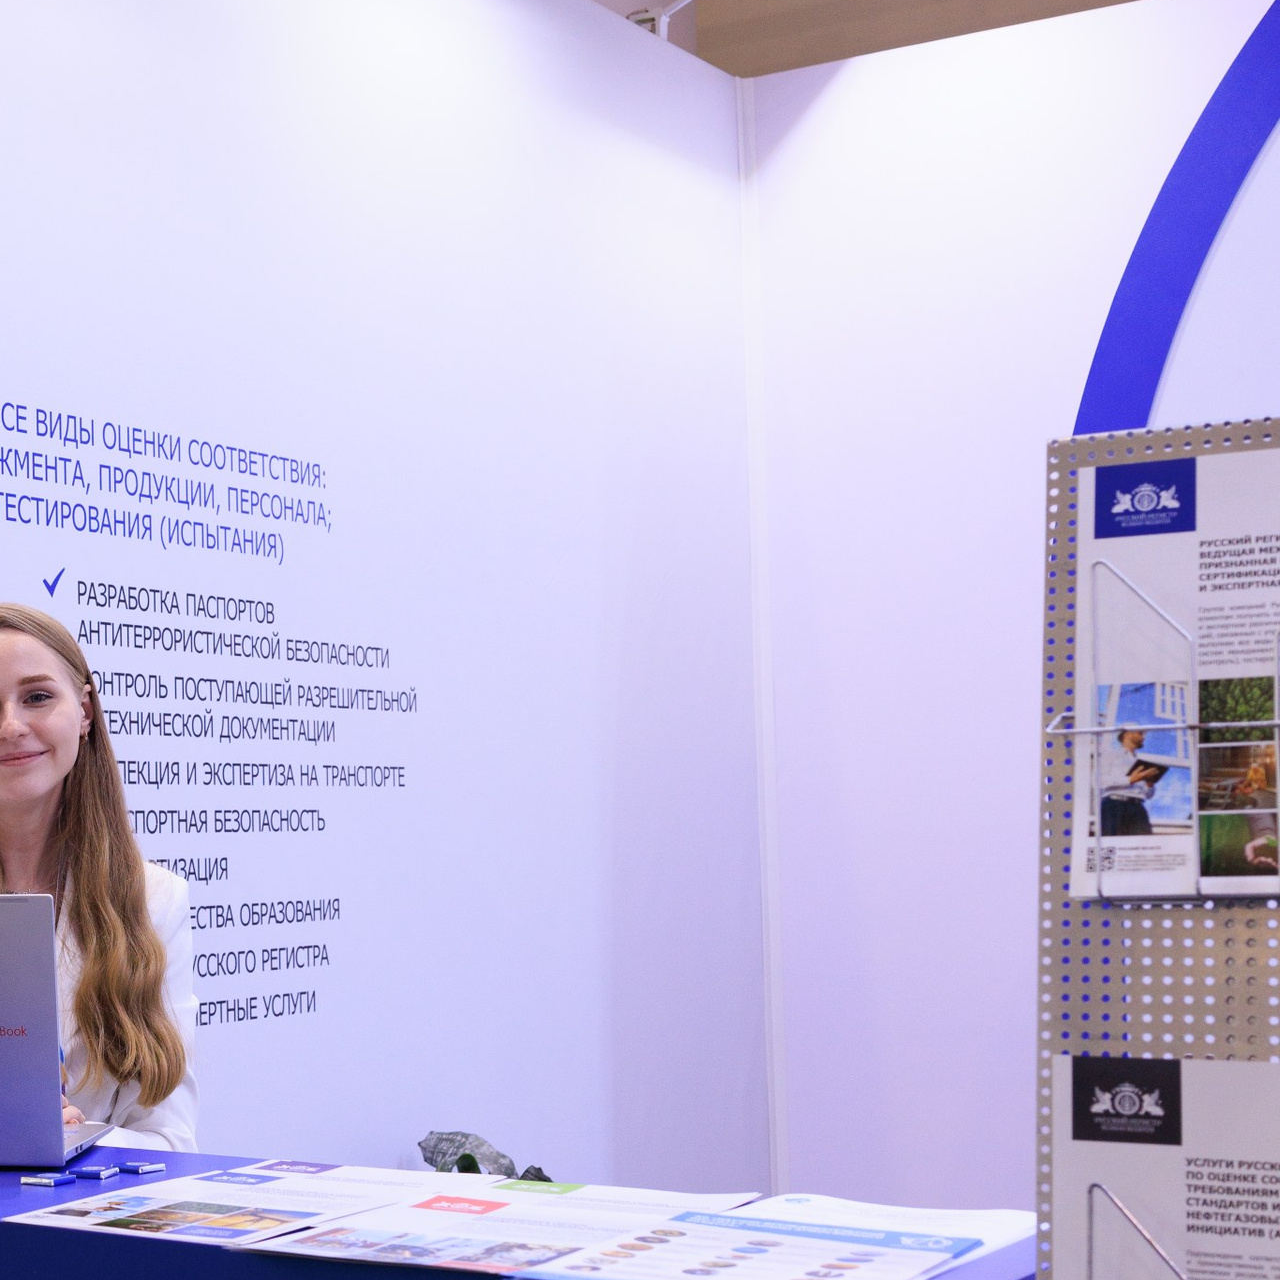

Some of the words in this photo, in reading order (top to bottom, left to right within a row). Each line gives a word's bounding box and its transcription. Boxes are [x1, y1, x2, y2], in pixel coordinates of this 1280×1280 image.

[36, 408, 95, 449] ВИДЫ
[102, 422, 182, 462] ОЦЕНКИ
[188, 439, 326, 489] СООТВЕТСТВИЯ:
[99, 464, 220, 515] ПРОДУКЦИИ,
[228, 486, 331, 533] ПЕРСОНАЛА;
[160, 516, 284, 565] (ИСПЫТАНИЯ)
[1200, 535, 1252, 548] РУССКИЙ
[77, 580, 181, 615] РАЗРАБОТКА
[186, 593, 275, 624] ПАСПОРТОВ
[77, 619, 280, 661] АНТИТЕРРОРИСТИЧЕСКОЙ
[286, 639, 390, 669] БЕЗОПАСНОСТИ
[91, 670, 168, 699] ОНТРОЛЬ
[174, 676, 292, 710] ПОСТУПАЮЩЕЙ
[298, 685, 417, 713] РАЗРЕШИТЕЛЬНОЙ
[219, 715, 336, 746] ДОКУМЕНТАЦИИ
[117, 761, 180, 790] ПЕКЦИЯ
[187, 762, 197, 785] И
[203, 762, 295, 786] ЭКСПЕРТИЗА
[300, 764, 319, 786] НА
[322, 765, 405, 787] ТРАНСПОРТЕ
[129, 809, 208, 835] ПОРТНАЯ
[214, 809, 325, 833] БЕЗОПАСНОСТЬ
[190, 904, 236, 930] ЕСТВА
[240, 898, 340, 926] ОБРАЗОВАНИЯ
[262, 944, 329, 972] РЕГИСТРА
[195, 997, 258, 1027] ЕРТНЫЕ
[262, 990, 316, 1018] УСЛУГИ
[1185, 1158, 1234, 1169] УСЛУГИ
[1238, 1161, 1280, 1171] РУССК
[1186, 1170, 1204, 1180] ПО
[1207, 1172, 1256, 1183] ОЦЕНКЕ
[1186, 1183, 1279, 1198] ТРЕБОВАНИЯМ
[1186, 1197, 1268, 1211] СТАНДАРТОВ
[1186, 1224, 1266, 1238] ИНИЦИАТИВ
